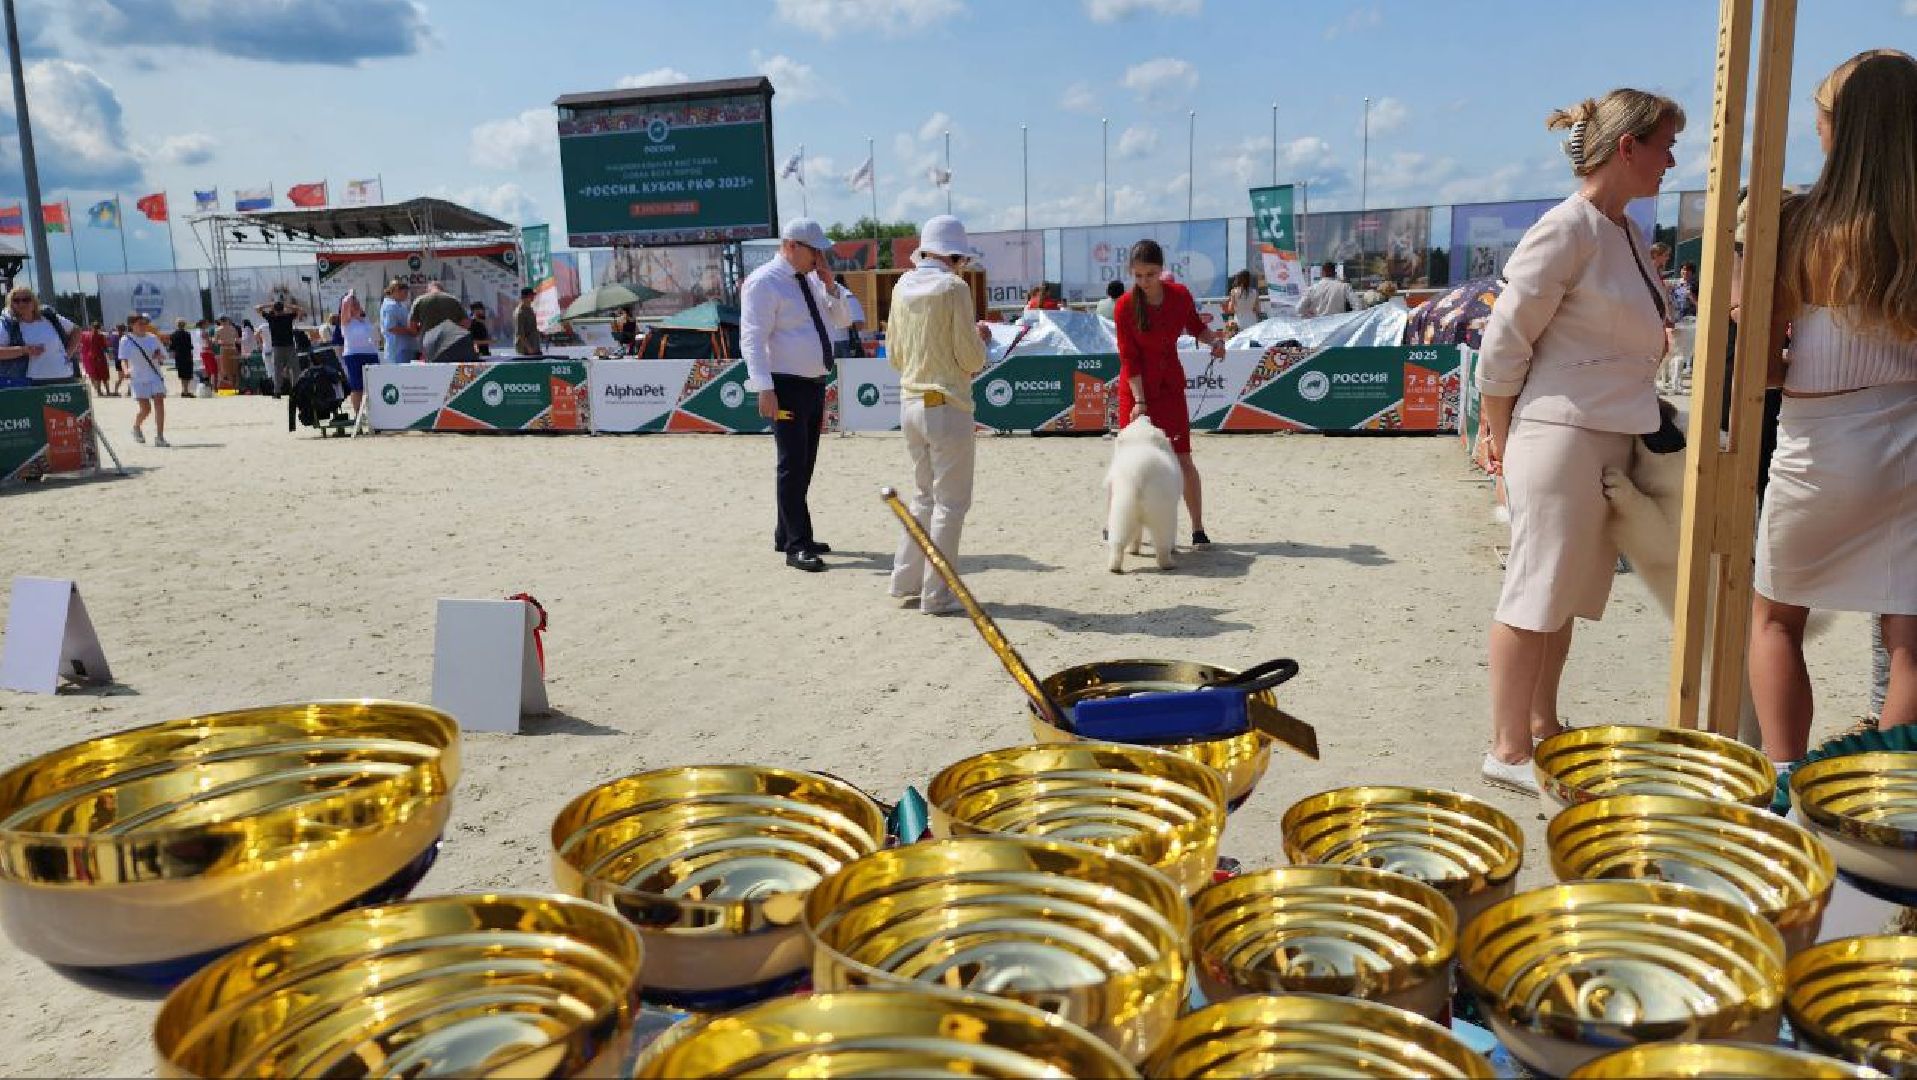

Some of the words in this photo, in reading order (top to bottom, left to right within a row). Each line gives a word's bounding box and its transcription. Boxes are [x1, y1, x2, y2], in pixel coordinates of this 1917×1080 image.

[642, 181, 685, 192] КУБОК
[687, 178, 715, 190] РКФ
[1408, 350, 1438, 360] 2025
[1077, 359, 1102, 369] 2025
[1332, 372, 1389, 384] РОССИЯ
[503, 383, 541, 393] РОССИЯ
[1014, 380, 1061, 391] РОССИЯ
[604, 383, 665, 401] AlphaPet
[45, 392, 72, 404] 2025
